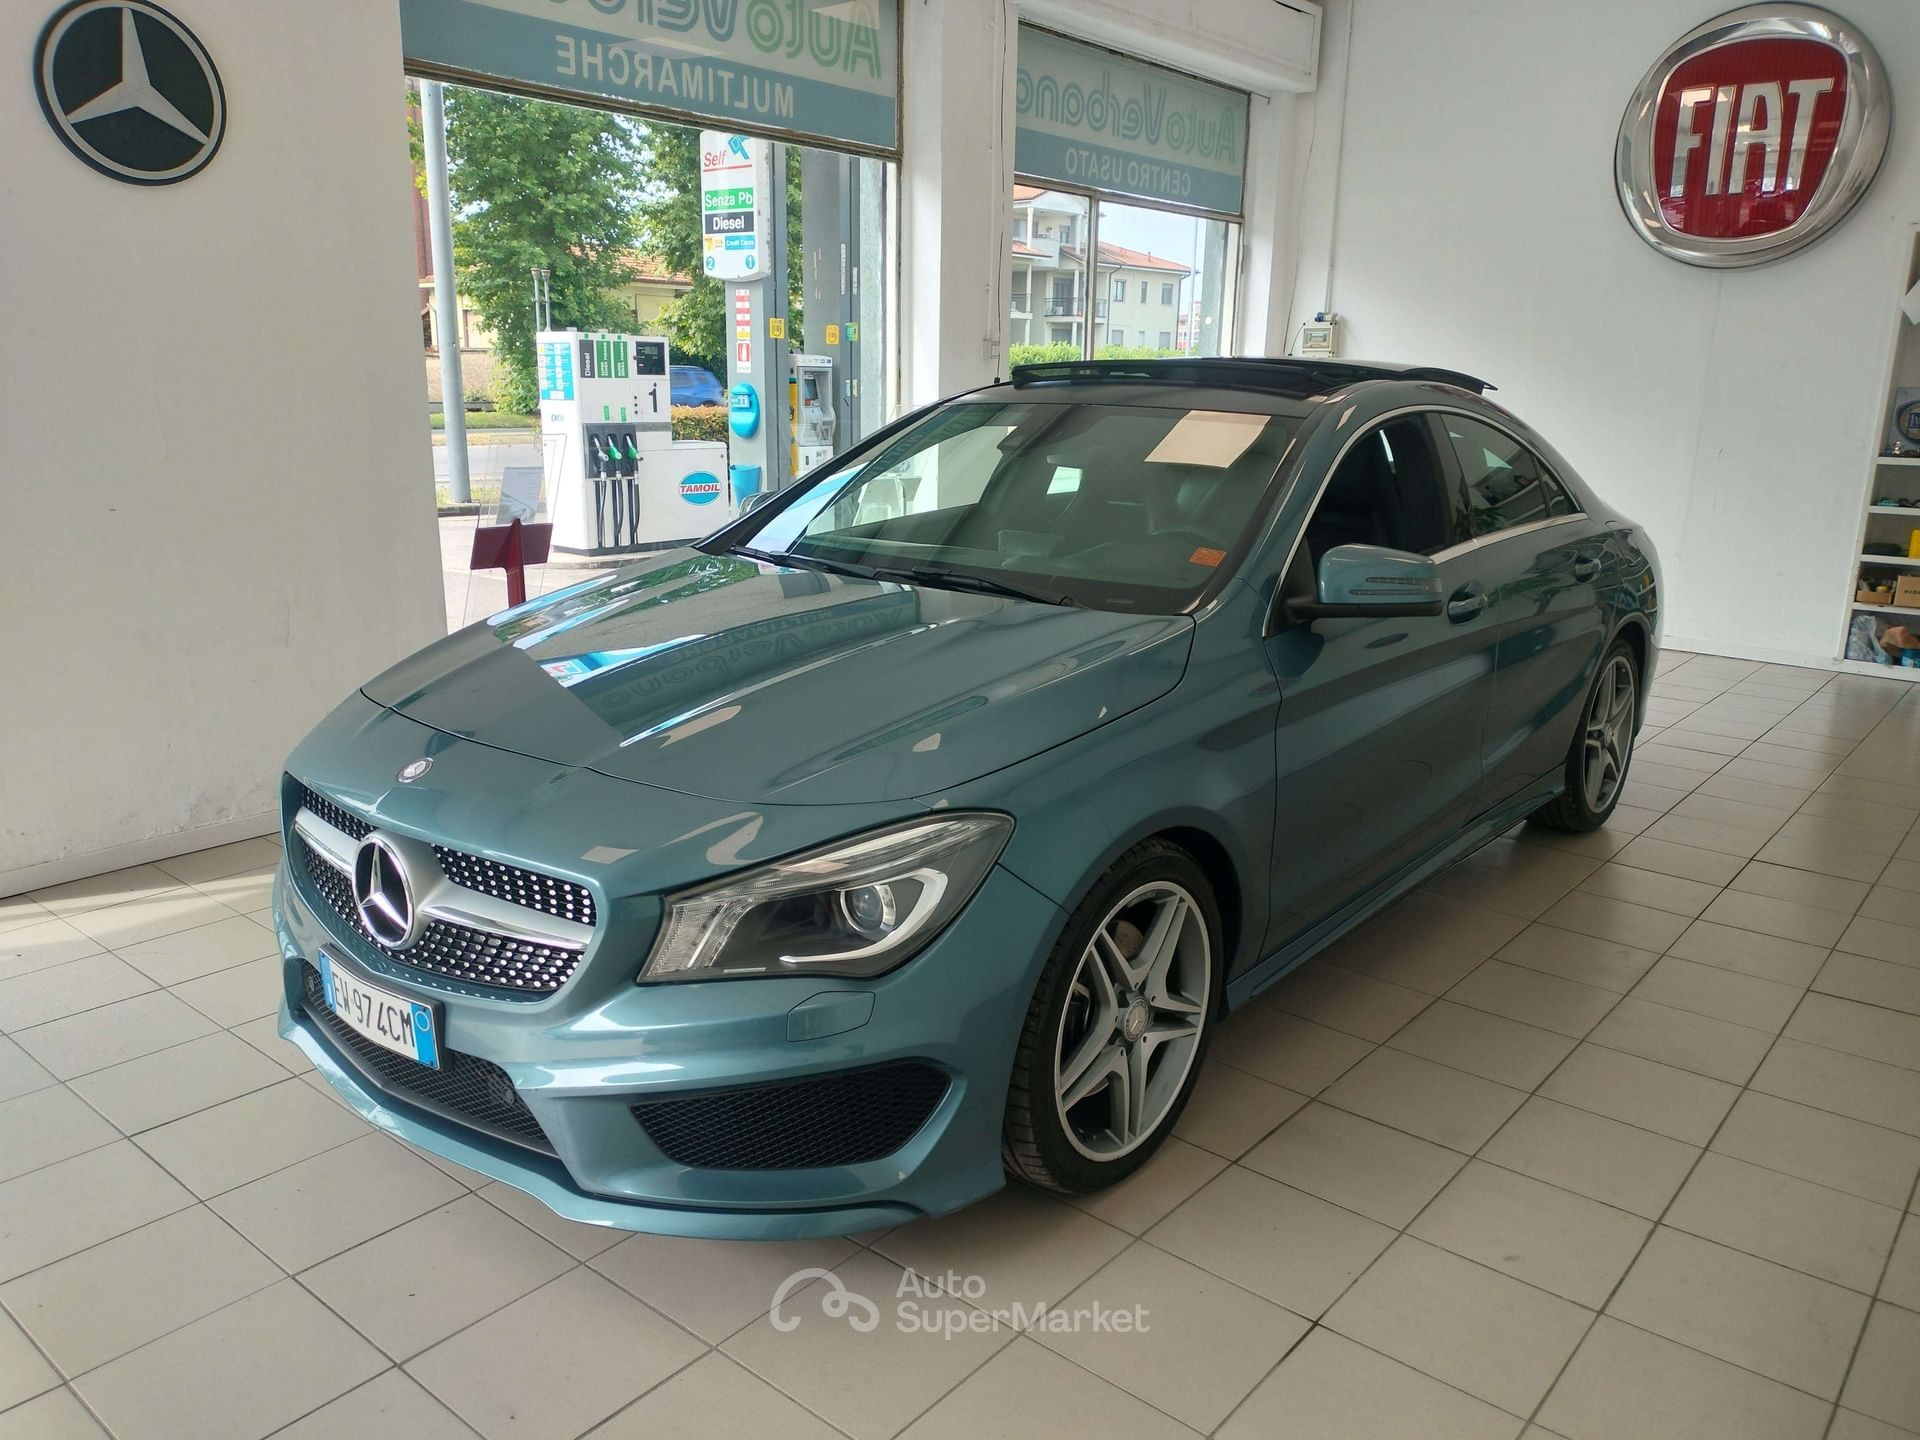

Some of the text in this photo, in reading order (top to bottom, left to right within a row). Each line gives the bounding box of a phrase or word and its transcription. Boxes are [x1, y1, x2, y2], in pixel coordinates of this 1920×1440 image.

[1669, 77, 1835, 198] FIAT
[703, 150, 727, 168] Self
[705, 191, 753, 208] Senza Pb
[712, 215, 745, 231] Diesel
[649, 387, 658, 413] 1
[680, 483, 721, 494] TAMOIL
